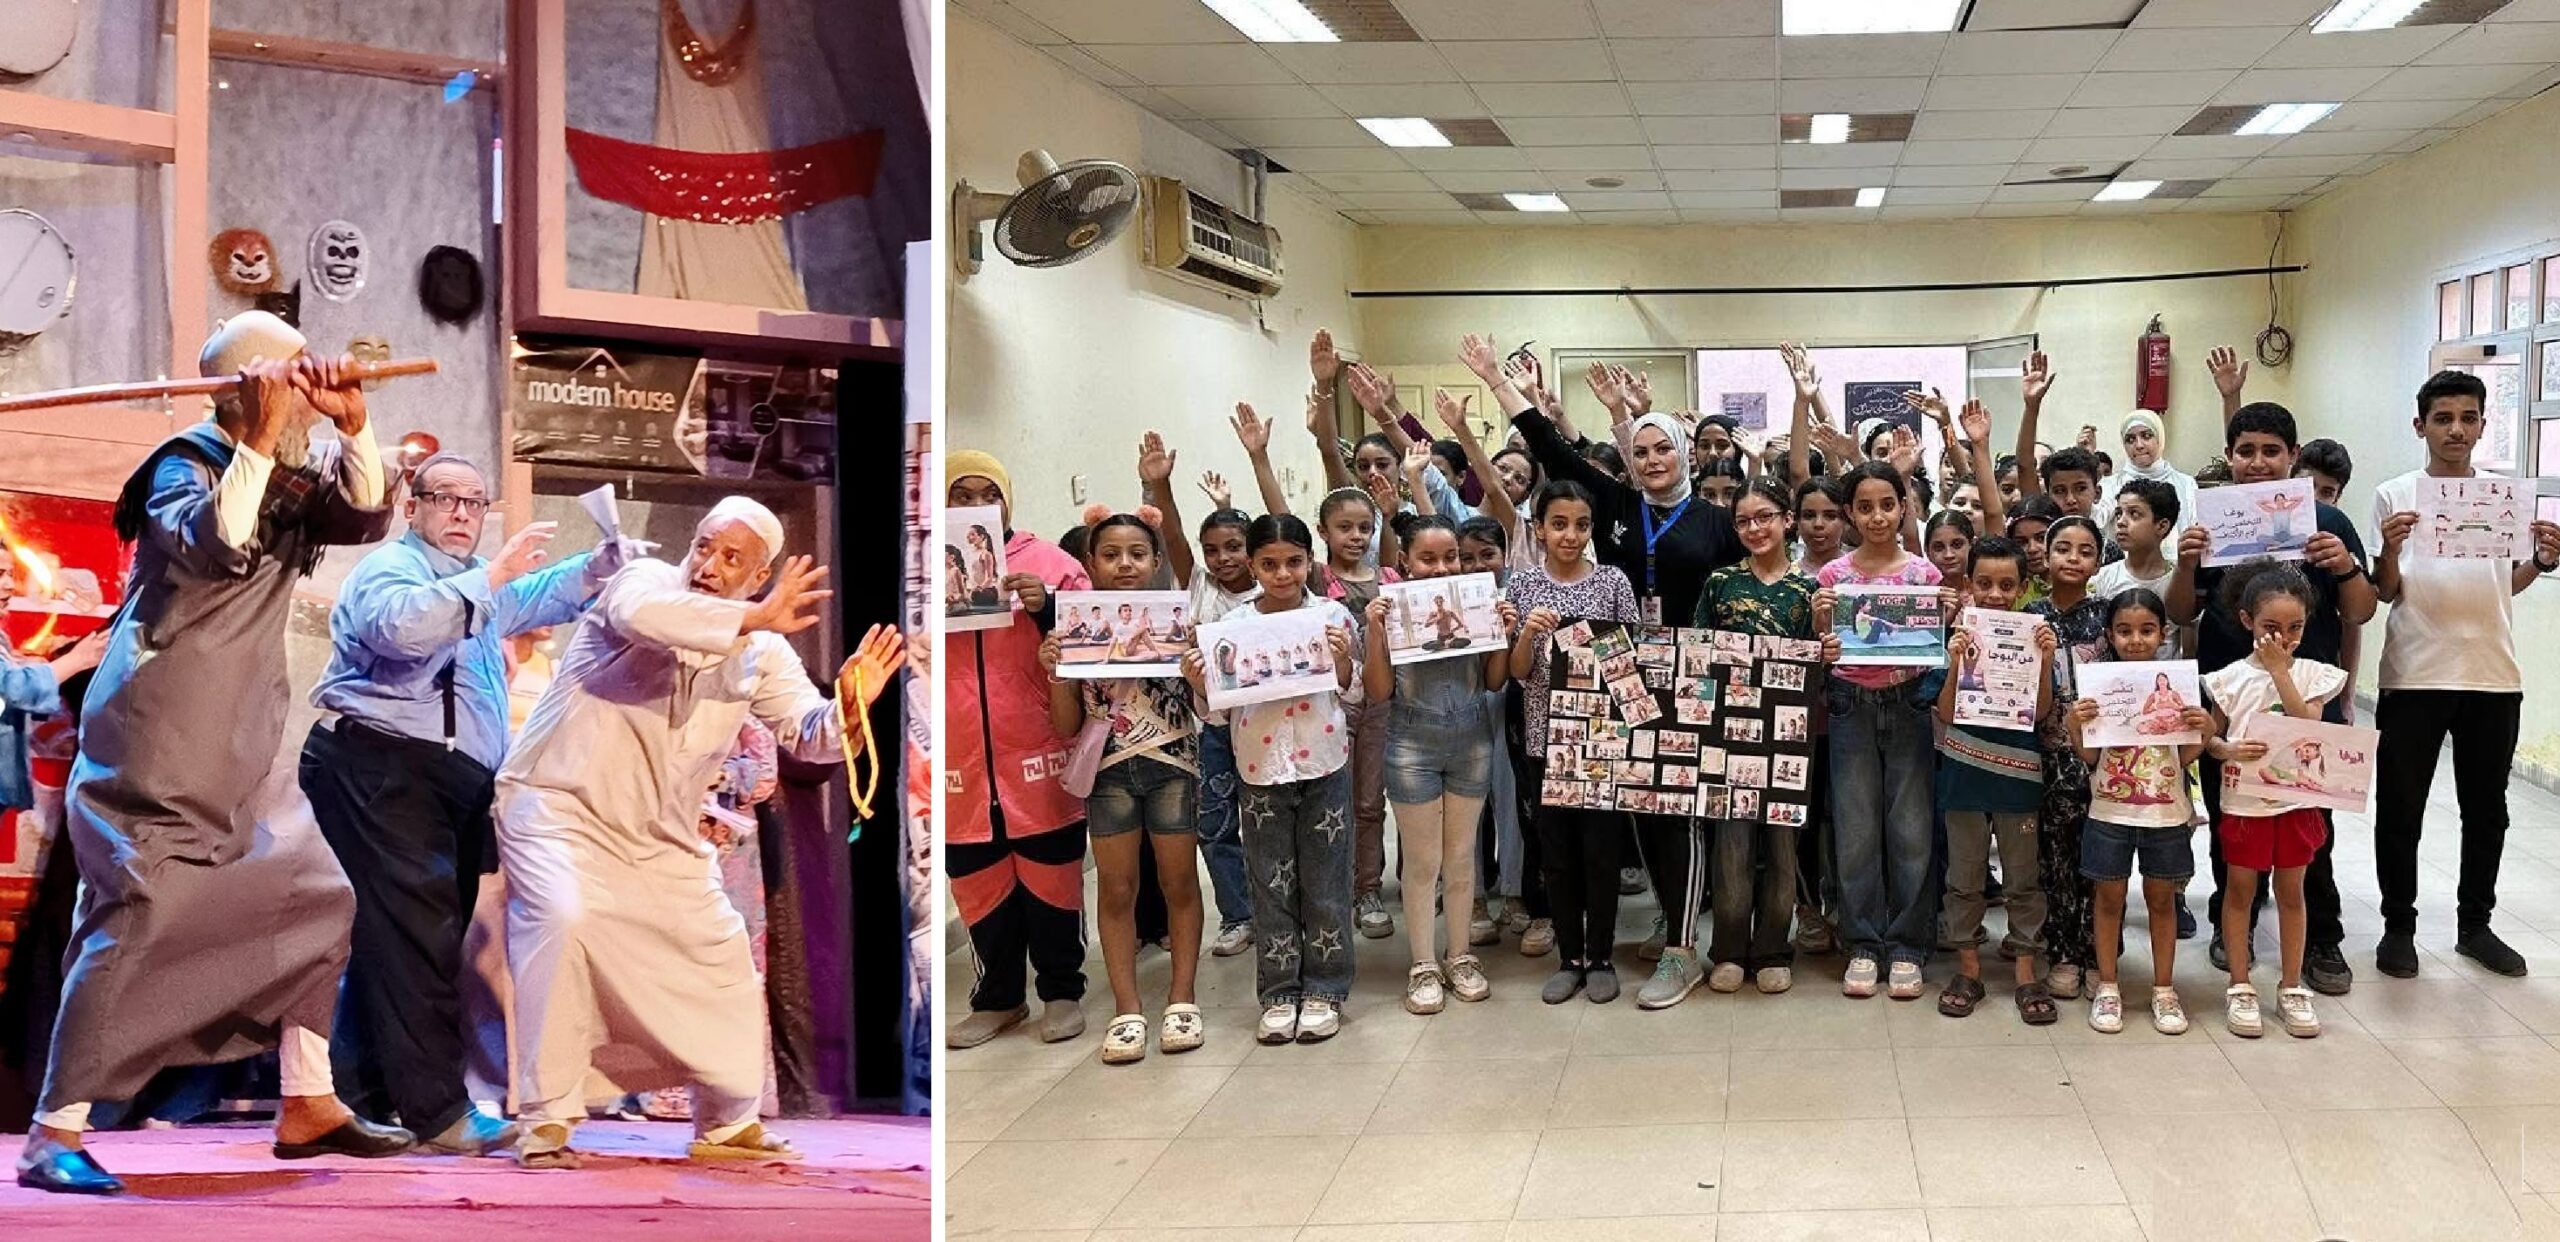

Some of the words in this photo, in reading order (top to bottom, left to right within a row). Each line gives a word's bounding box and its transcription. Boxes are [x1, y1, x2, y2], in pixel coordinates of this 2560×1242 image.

[527, 377, 612, 407] modern
[613, 381, 676, 412] house
[1879, 596, 1906, 604] YOGA
[1988, 650, 2018, 662] اليوجا
